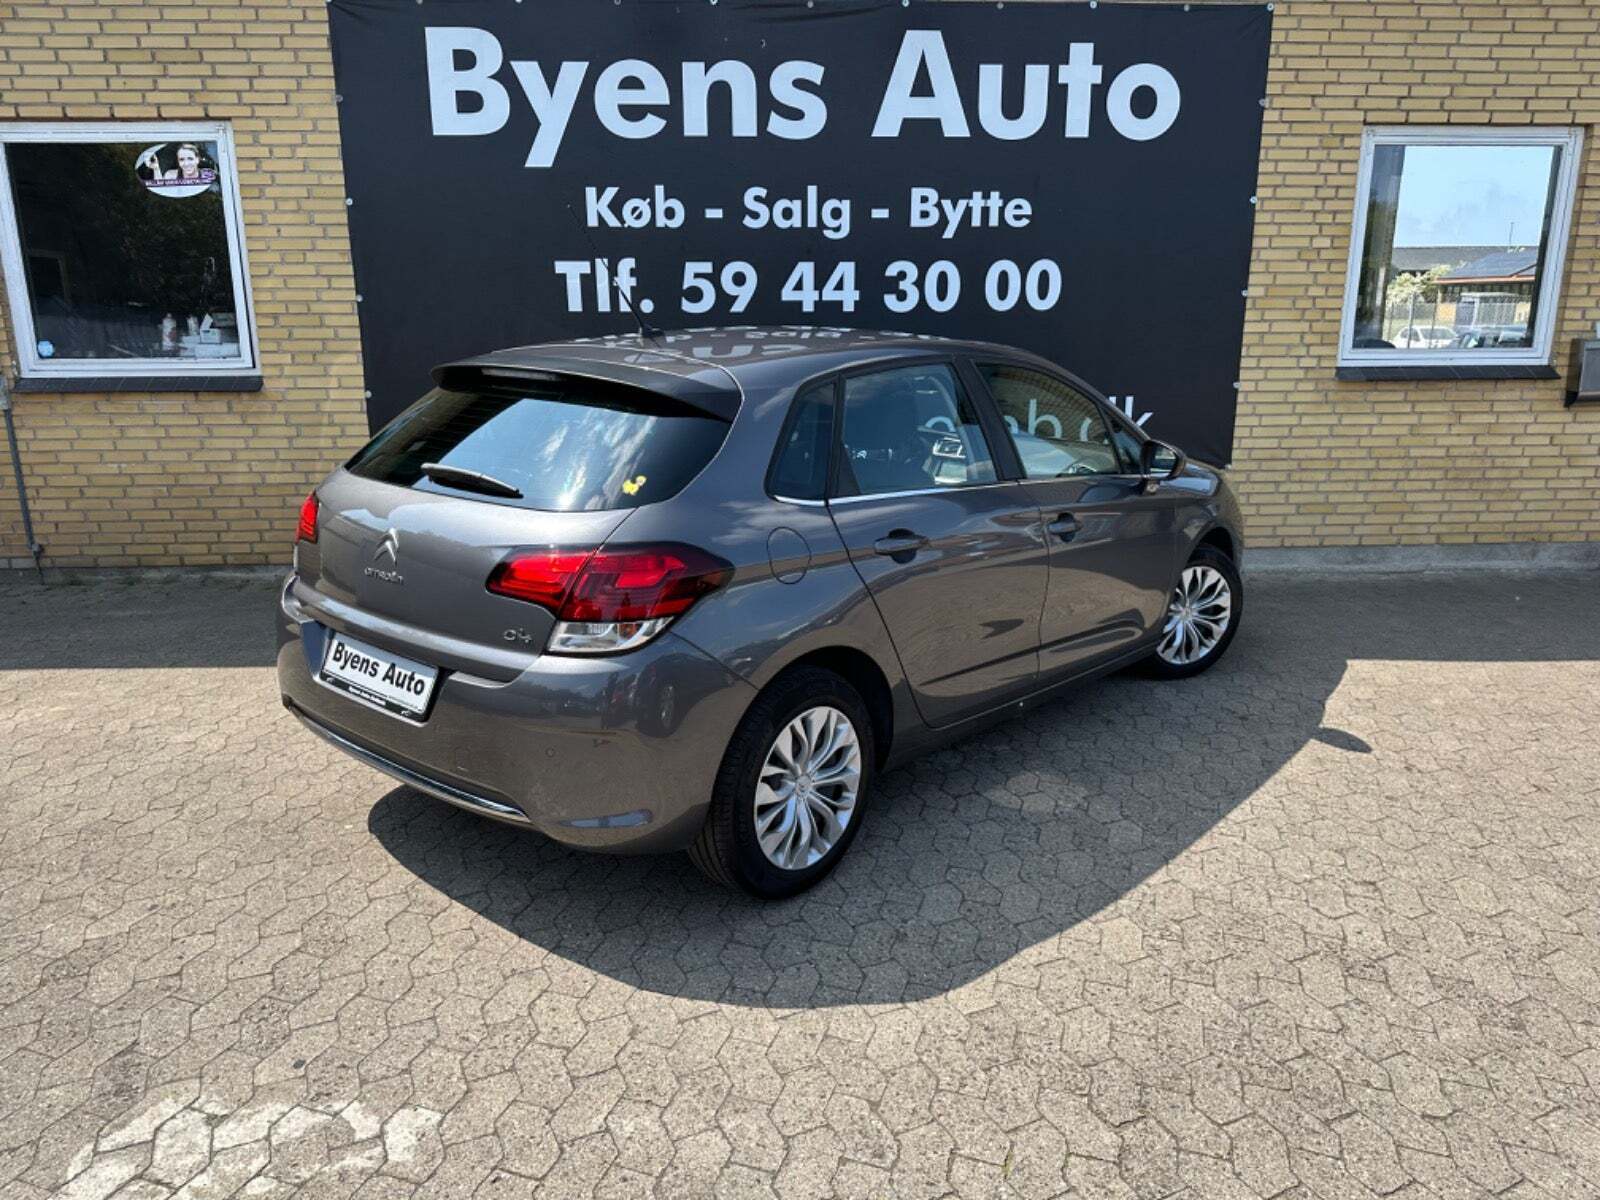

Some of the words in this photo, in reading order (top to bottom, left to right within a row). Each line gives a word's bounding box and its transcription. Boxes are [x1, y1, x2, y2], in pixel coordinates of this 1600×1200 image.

[425, 27, 827, 167] Byens
[871, 30, 1180, 140] Auto
[586, 185, 684, 229] Køb
[705, 209, 723, 218] -
[743, 186, 850, 239] Salg
[871, 209, 889, 218] -
[910, 188, 1032, 238] Bytte
[555, 258, 654, 313] Tlf.
[682, 262, 757, 313] 59
[782, 262, 859, 312] 44
[884, 260, 960, 312] 30
[985, 259, 1061, 311] 00
[333, 642, 379, 678] Byens
[382, 662, 425, 696] Auto
